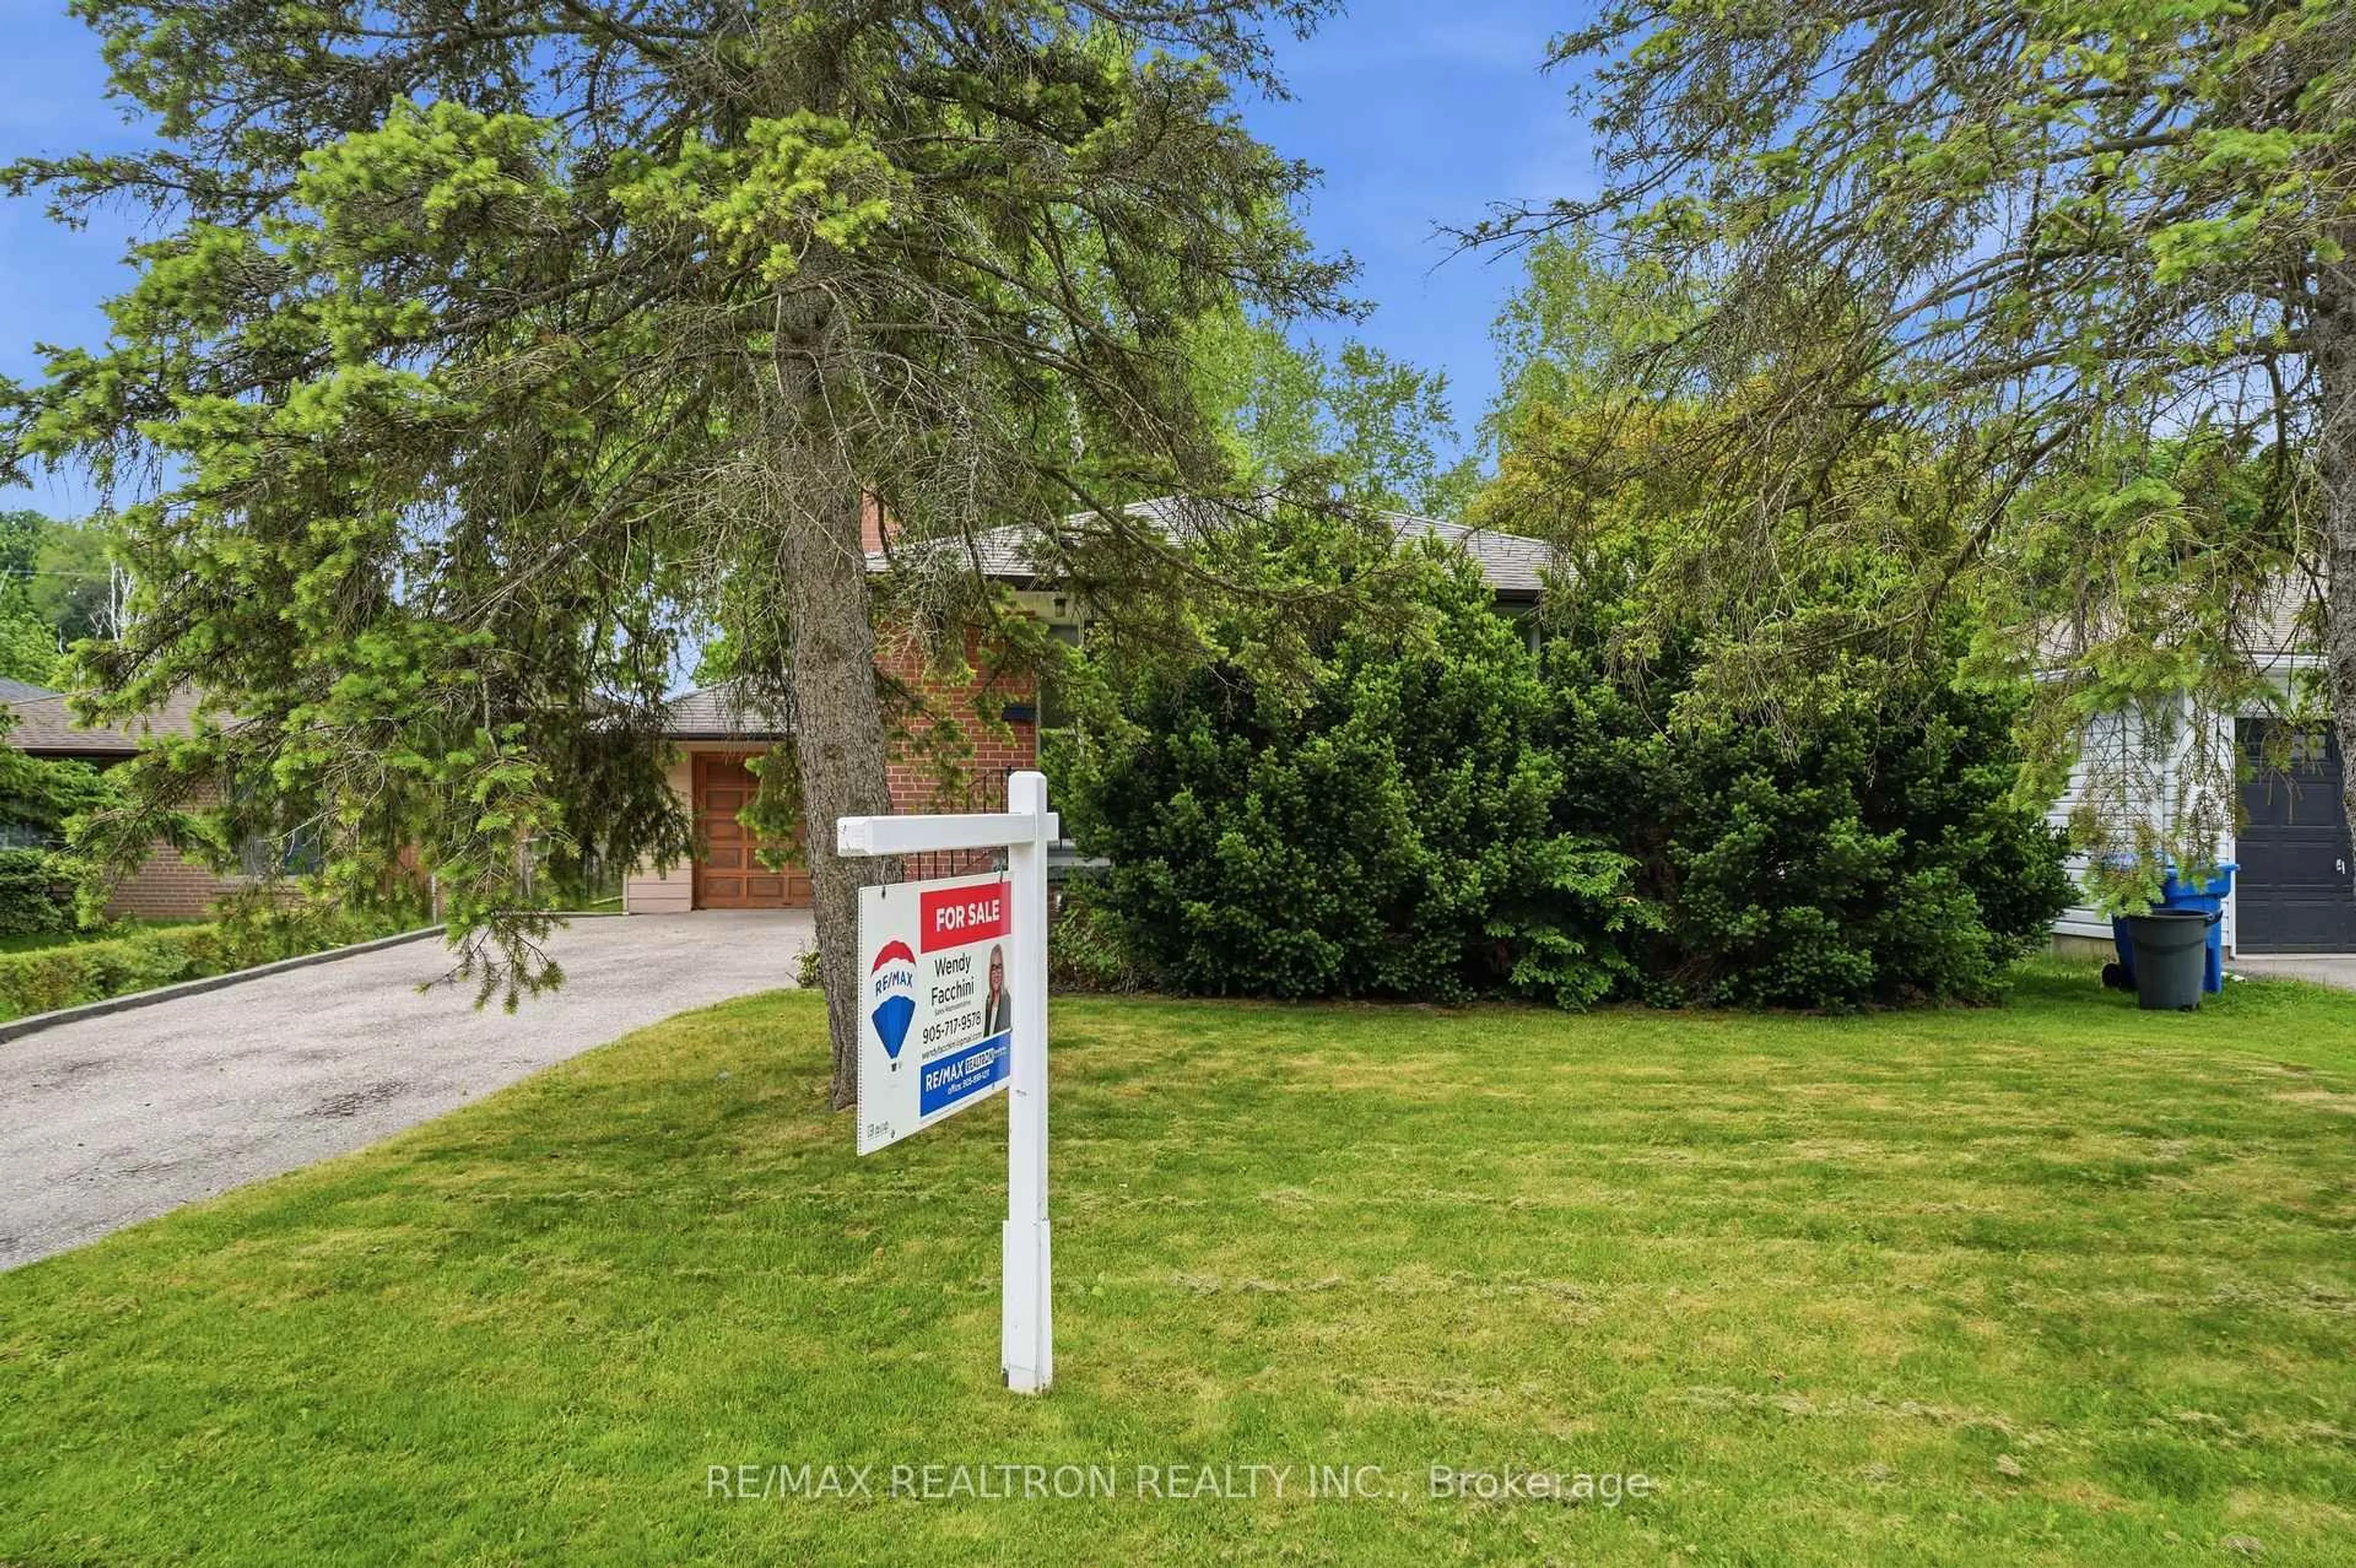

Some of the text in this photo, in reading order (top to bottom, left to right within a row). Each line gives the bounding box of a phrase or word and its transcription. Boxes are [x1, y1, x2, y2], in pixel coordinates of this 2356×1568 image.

[936, 899, 1000, 932] FOR SALE
[934, 952, 972, 977] Wendy
[876, 970, 913, 997] RE/MAX
[931, 976, 974, 1007] Facchini
[922, 1010, 982, 1045] 905-717-9578
[925, 1059, 964, 1093] RE/MAX
